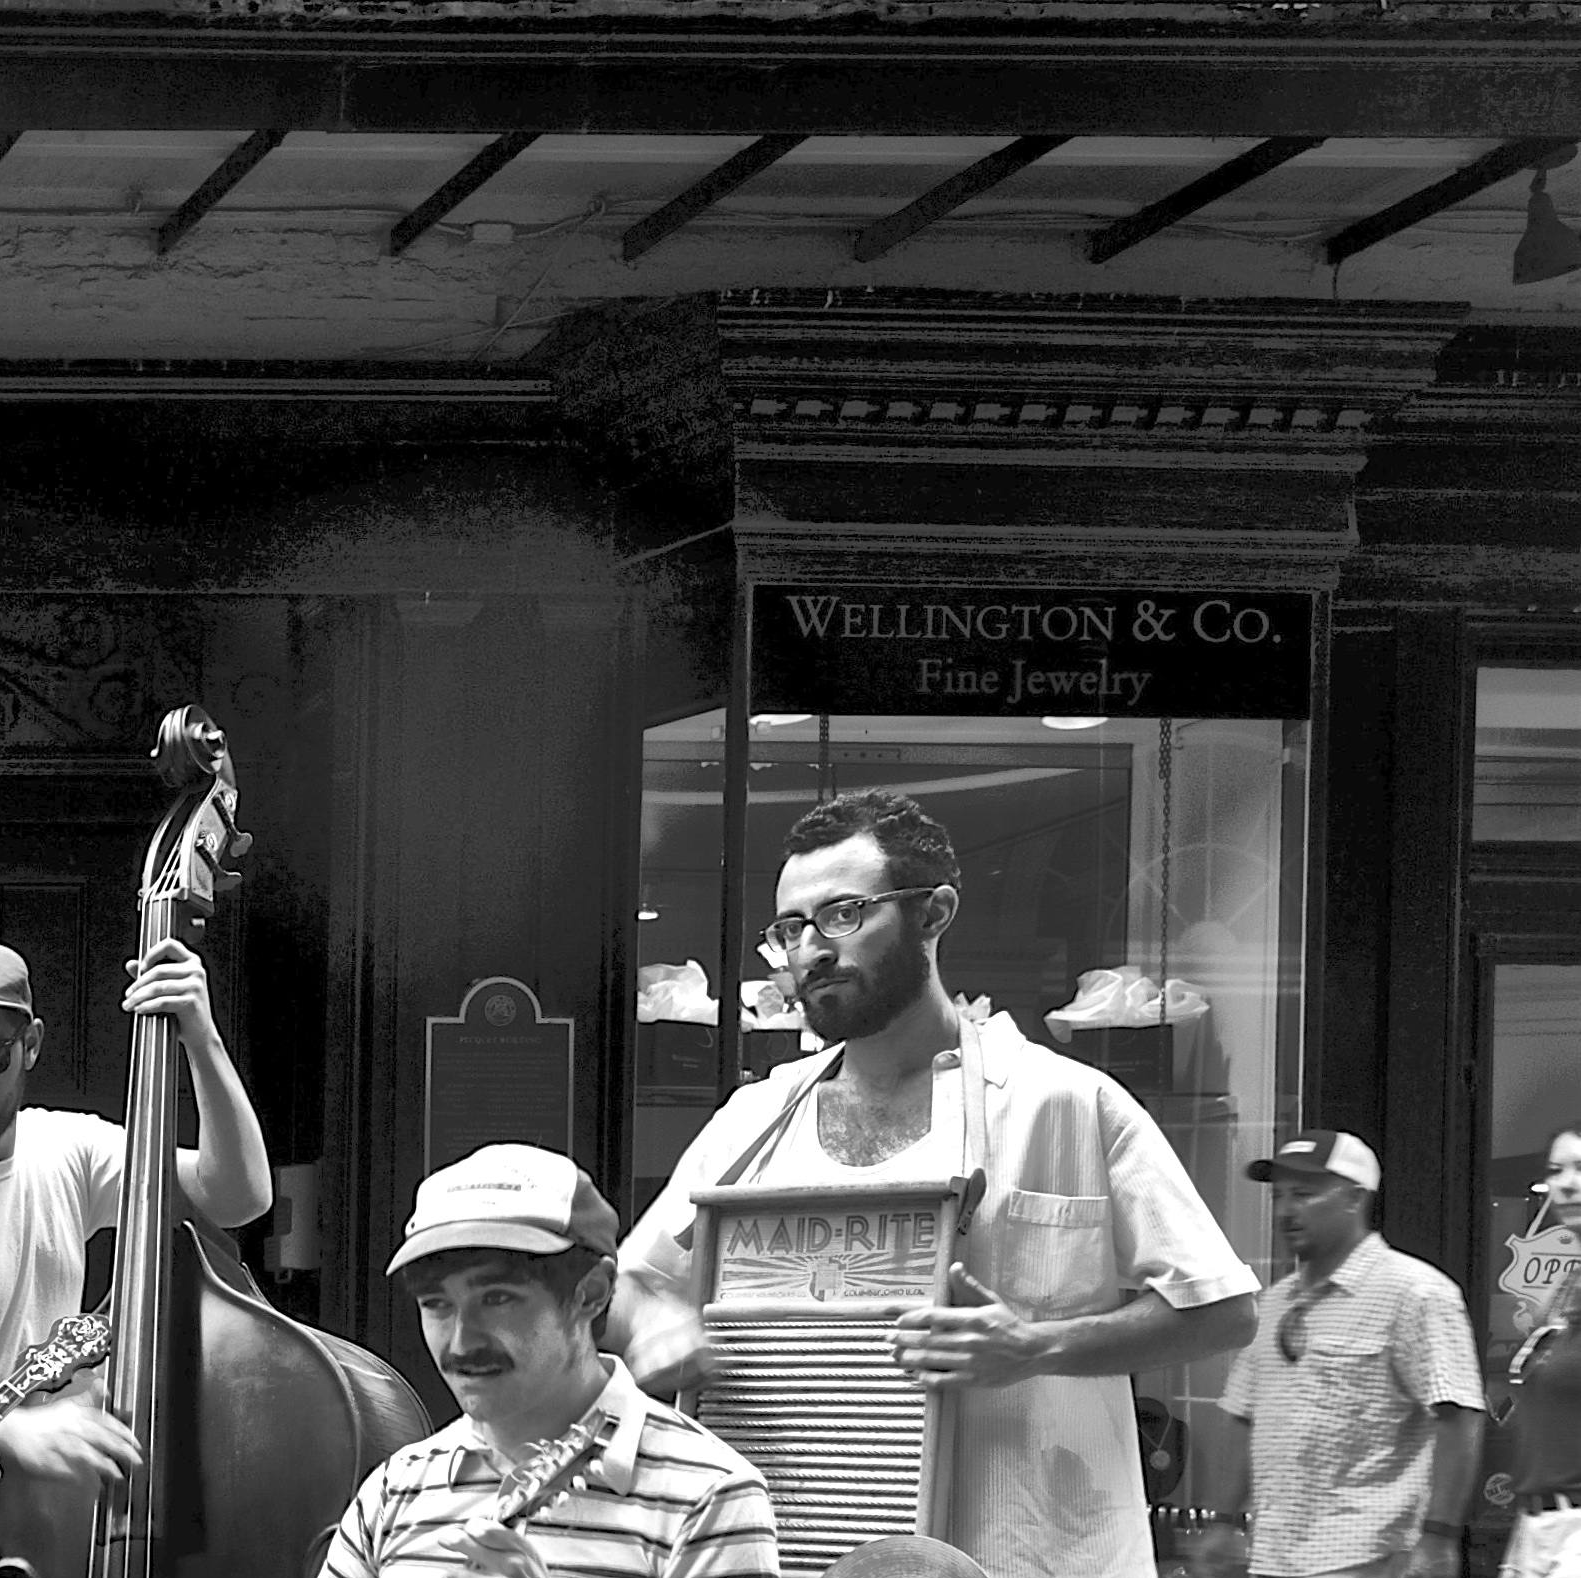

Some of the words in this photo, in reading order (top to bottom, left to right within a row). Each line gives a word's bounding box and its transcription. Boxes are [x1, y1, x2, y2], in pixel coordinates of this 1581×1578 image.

[785, 595, 1117, 643] WELLINGTON
[1131, 598, 1177, 643] &
[914, 658, 1002, 697] Fine
[1007, 658, 1154, 706] Jewelry
[726, 1212, 936, 1256] MAID-RITE
